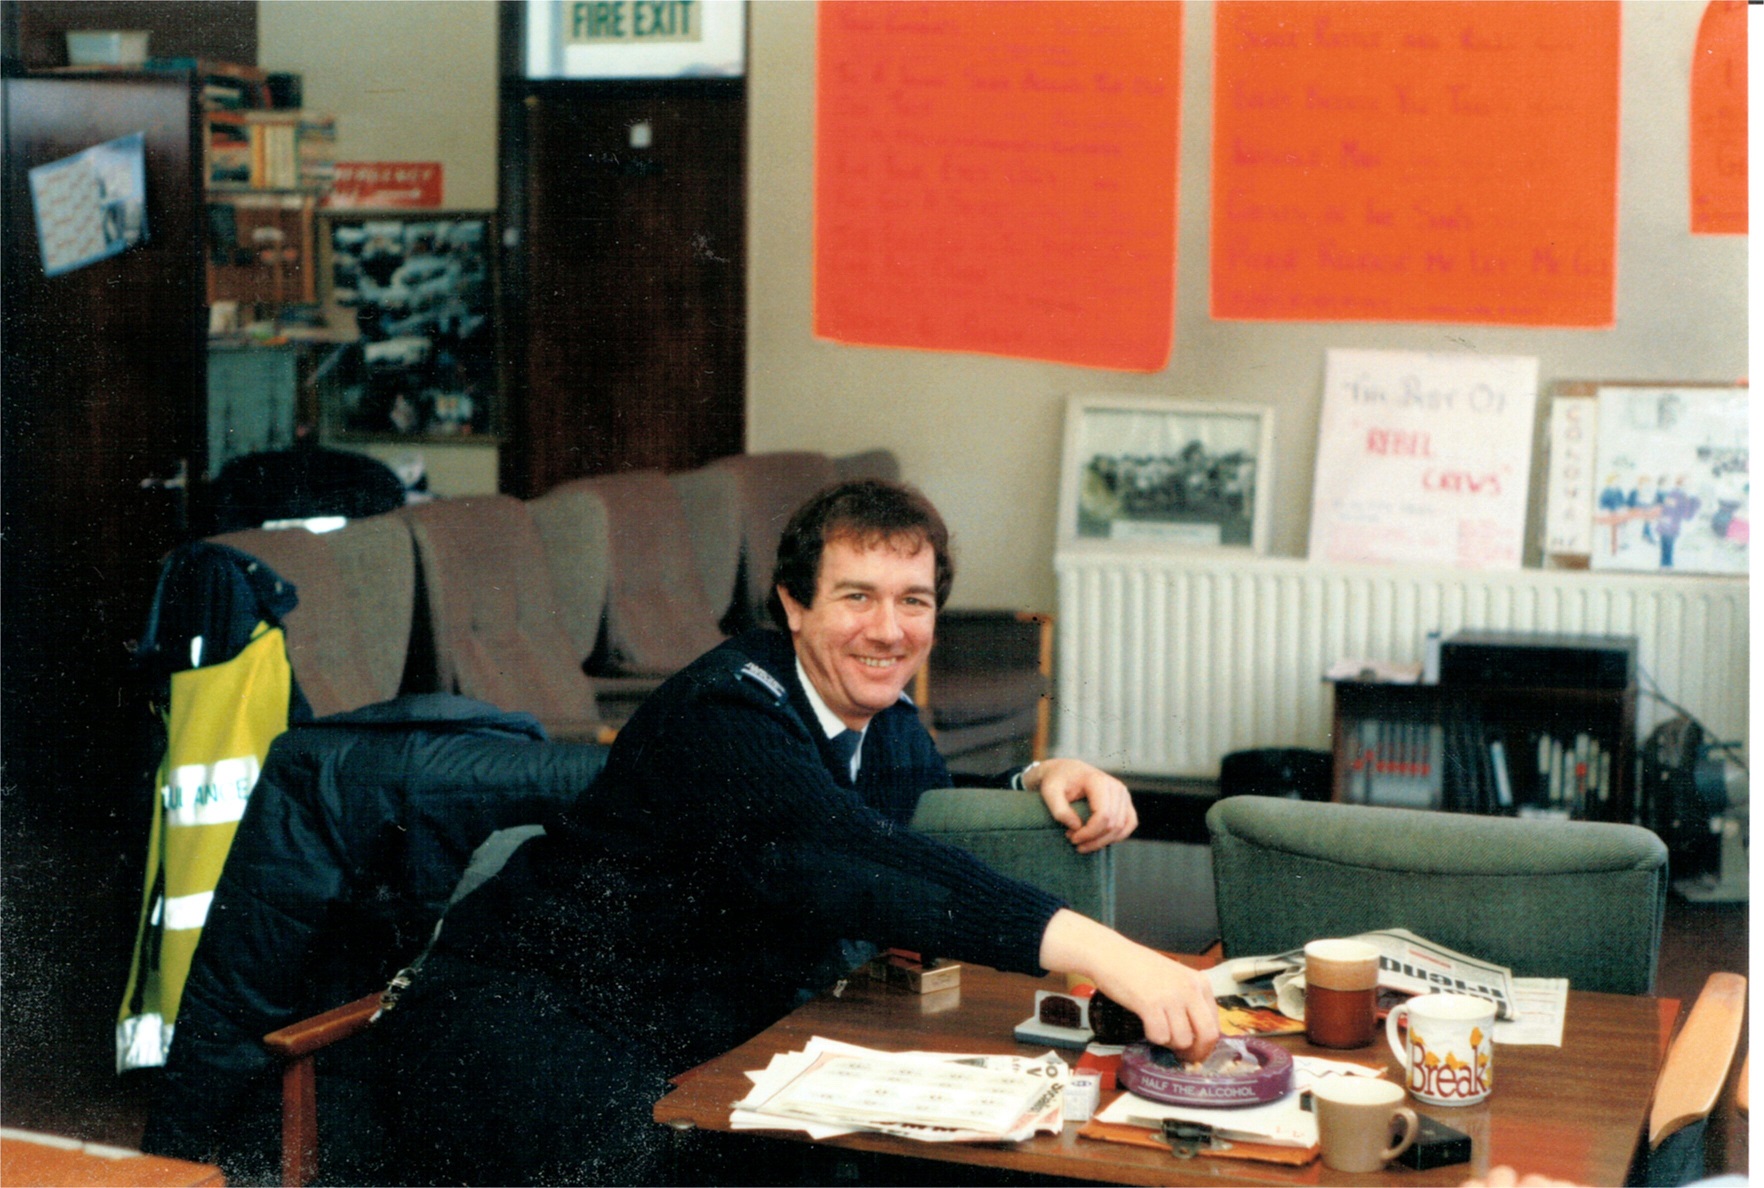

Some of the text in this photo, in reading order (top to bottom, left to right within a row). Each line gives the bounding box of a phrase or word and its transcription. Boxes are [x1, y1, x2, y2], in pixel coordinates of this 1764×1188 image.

[573, 1, 692, 37] FIRE EXIT
[1141, 1076, 1256, 1097] HALF THE ALCOHOL
[1410, 1042, 1486, 1098] Break
